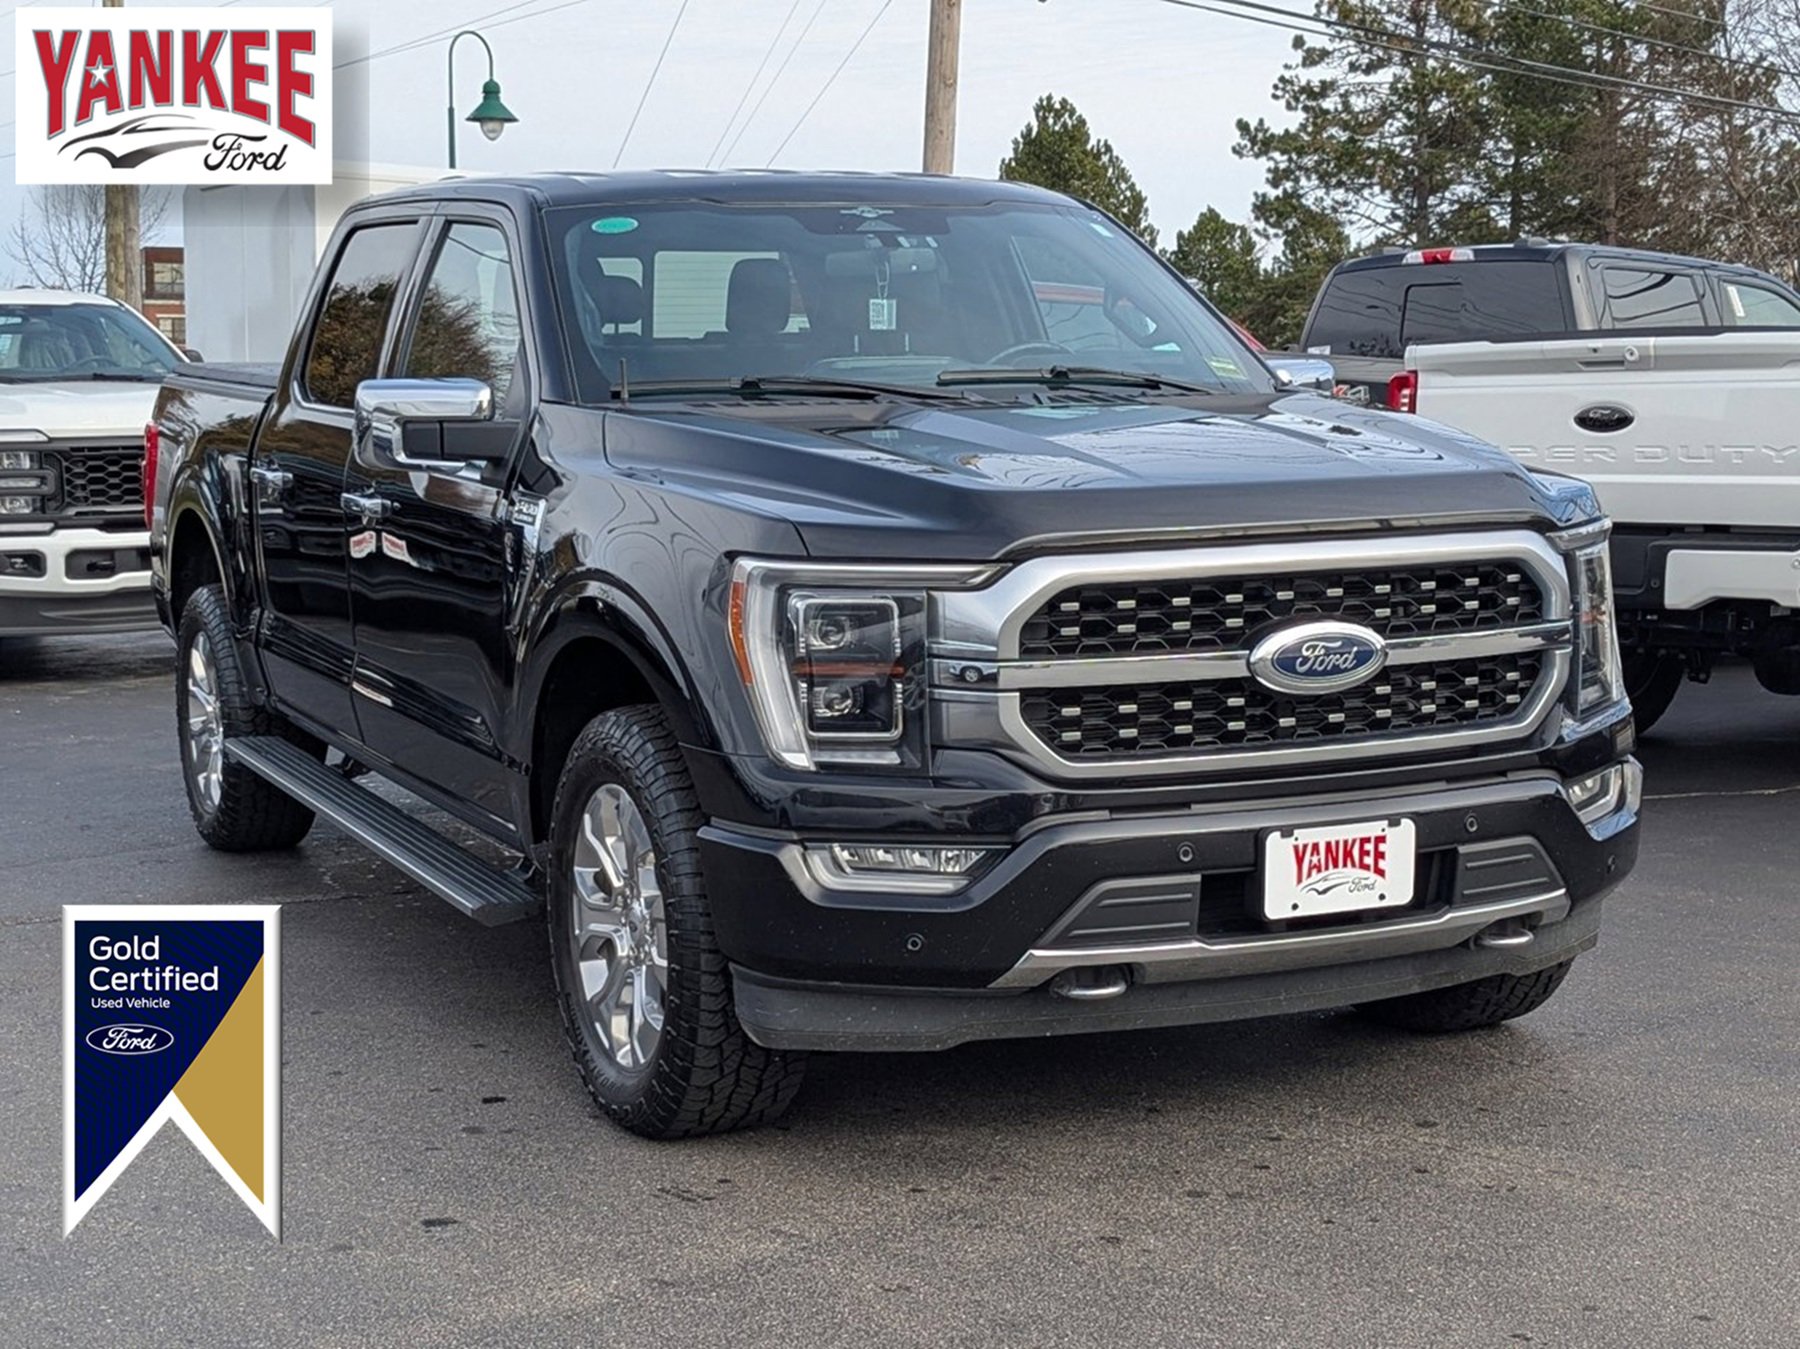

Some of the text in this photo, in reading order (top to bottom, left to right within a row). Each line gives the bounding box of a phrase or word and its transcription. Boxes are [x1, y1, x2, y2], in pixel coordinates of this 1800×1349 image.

[1507, 445, 1799, 464] PER DUTY
[1296, 641, 1357, 671] Ford
[1292, 834, 1387, 887] YANKEE
[1348, 876, 1377, 893] Ford
